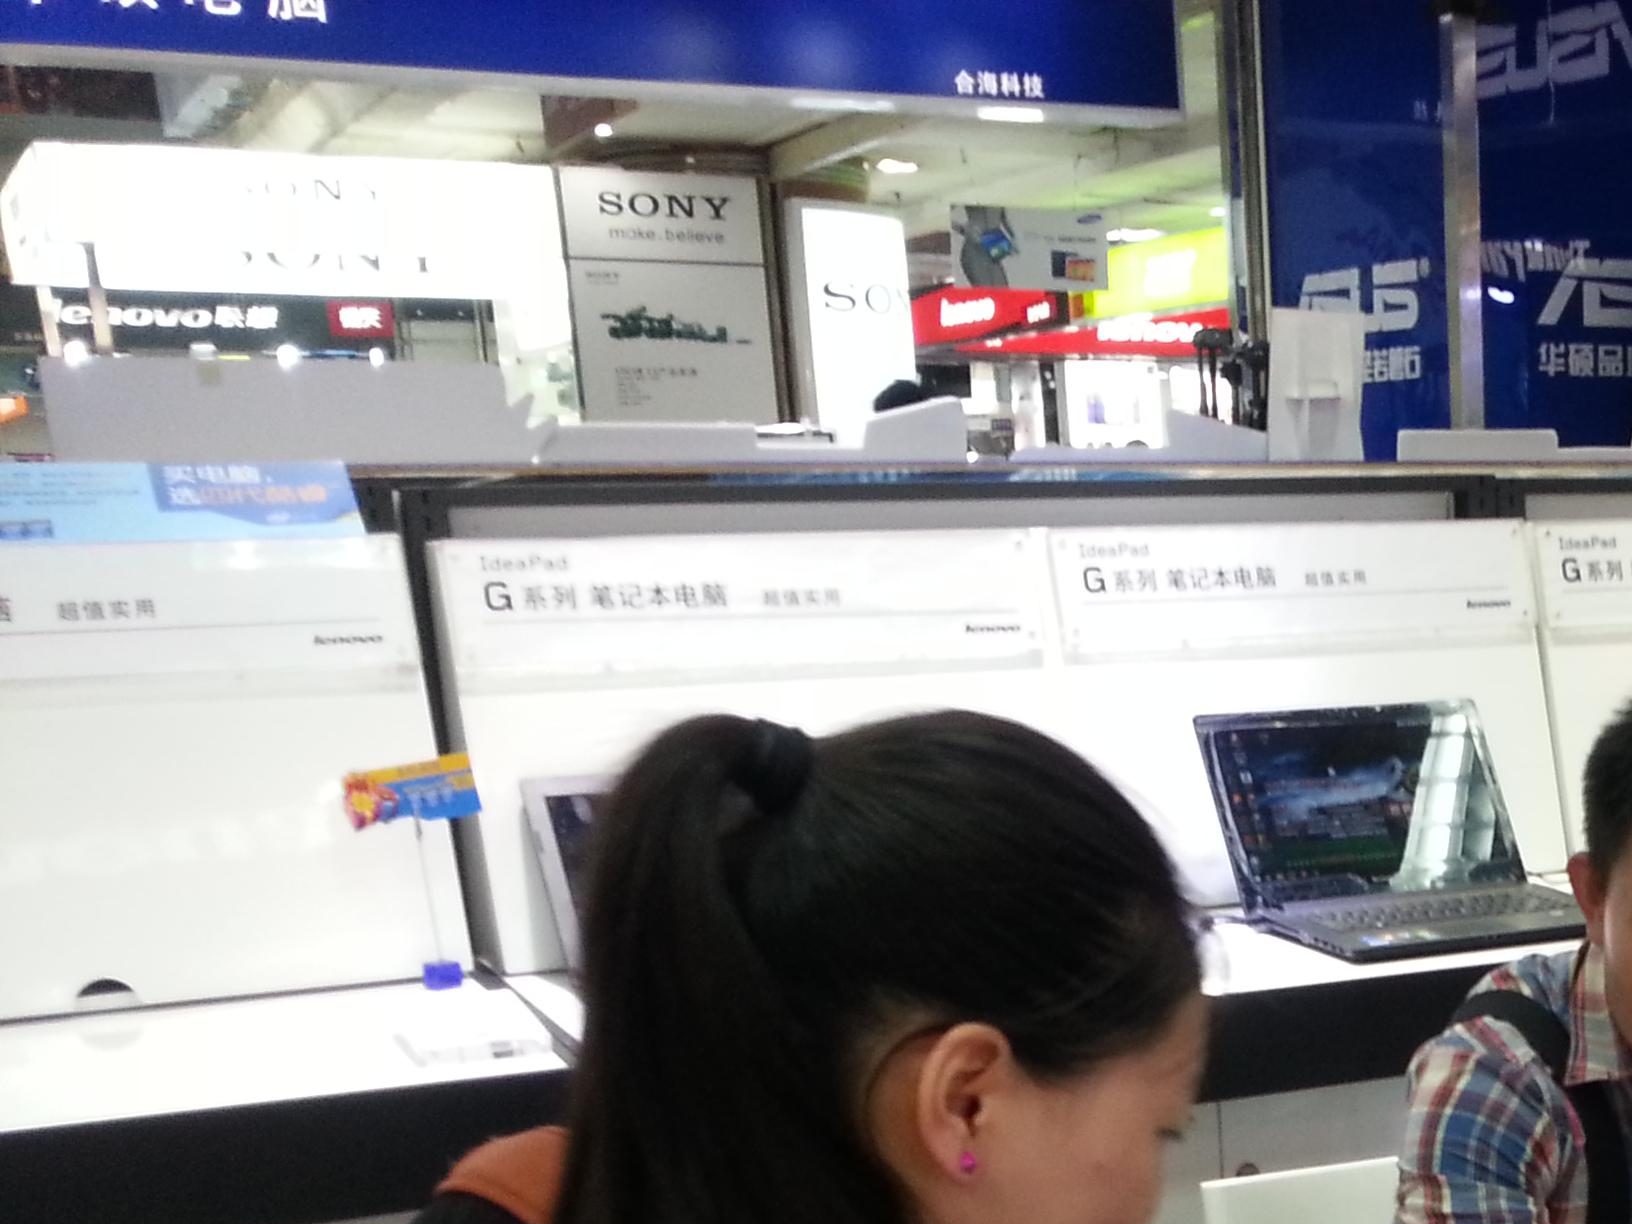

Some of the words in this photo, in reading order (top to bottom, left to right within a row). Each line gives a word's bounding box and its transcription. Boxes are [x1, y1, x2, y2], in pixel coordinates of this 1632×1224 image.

[598, 191, 732, 220] SONY
[57, 598, 156, 621] 超值实用
